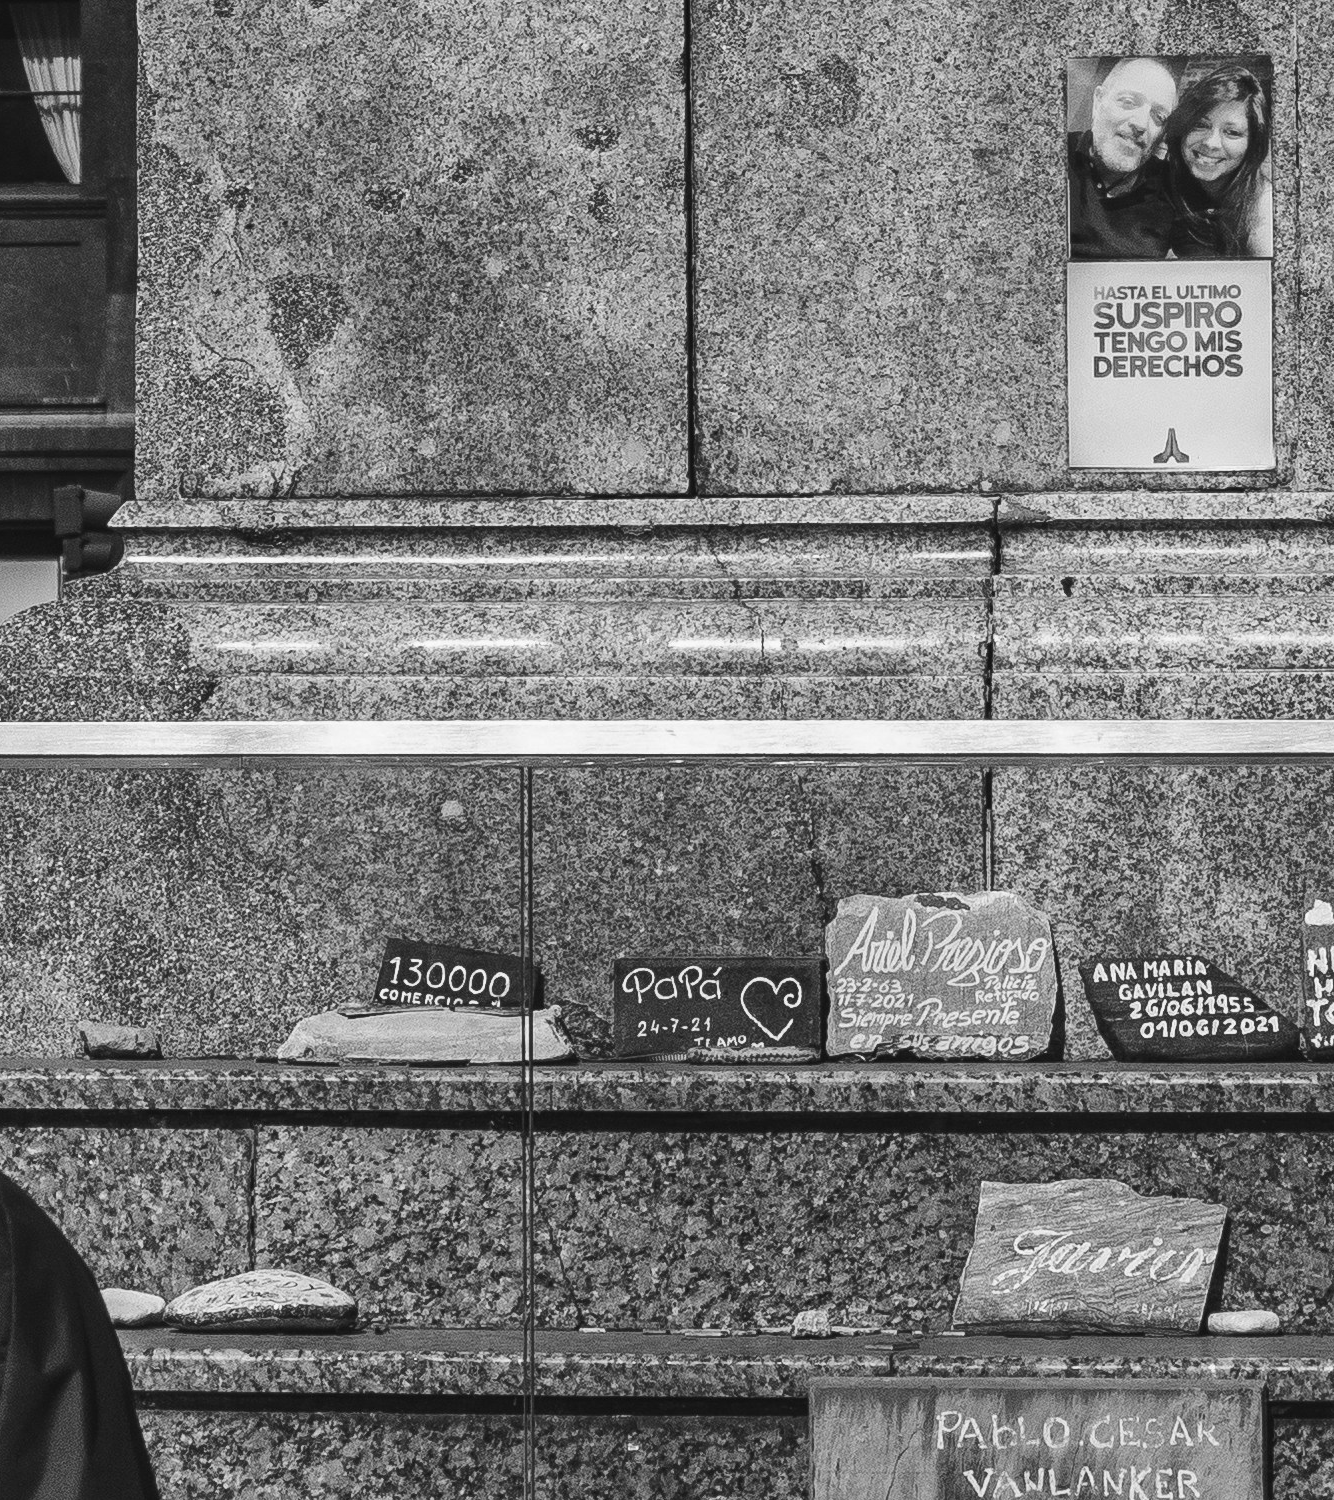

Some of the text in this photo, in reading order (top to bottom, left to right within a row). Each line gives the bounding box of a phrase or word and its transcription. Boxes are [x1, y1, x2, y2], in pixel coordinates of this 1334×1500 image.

[1094, 284, 1242, 300] HASTA EL ULTIMO
[1093, 301, 1242, 329] SUSPIRO
[1094, 330, 1243, 353] TENGO MIS
[1093, 354, 1244, 378] DERECHOS
[833, 907, 916, 976] Ariel
[389, 956, 510, 998] 130000
[1092, 962, 1137, 983] ANA
[637, 1016, 711, 1037] 24-7-21
[839, 998, 1021, 1033] Siempre Presente
[717, 1034, 747, 1047] AMO
